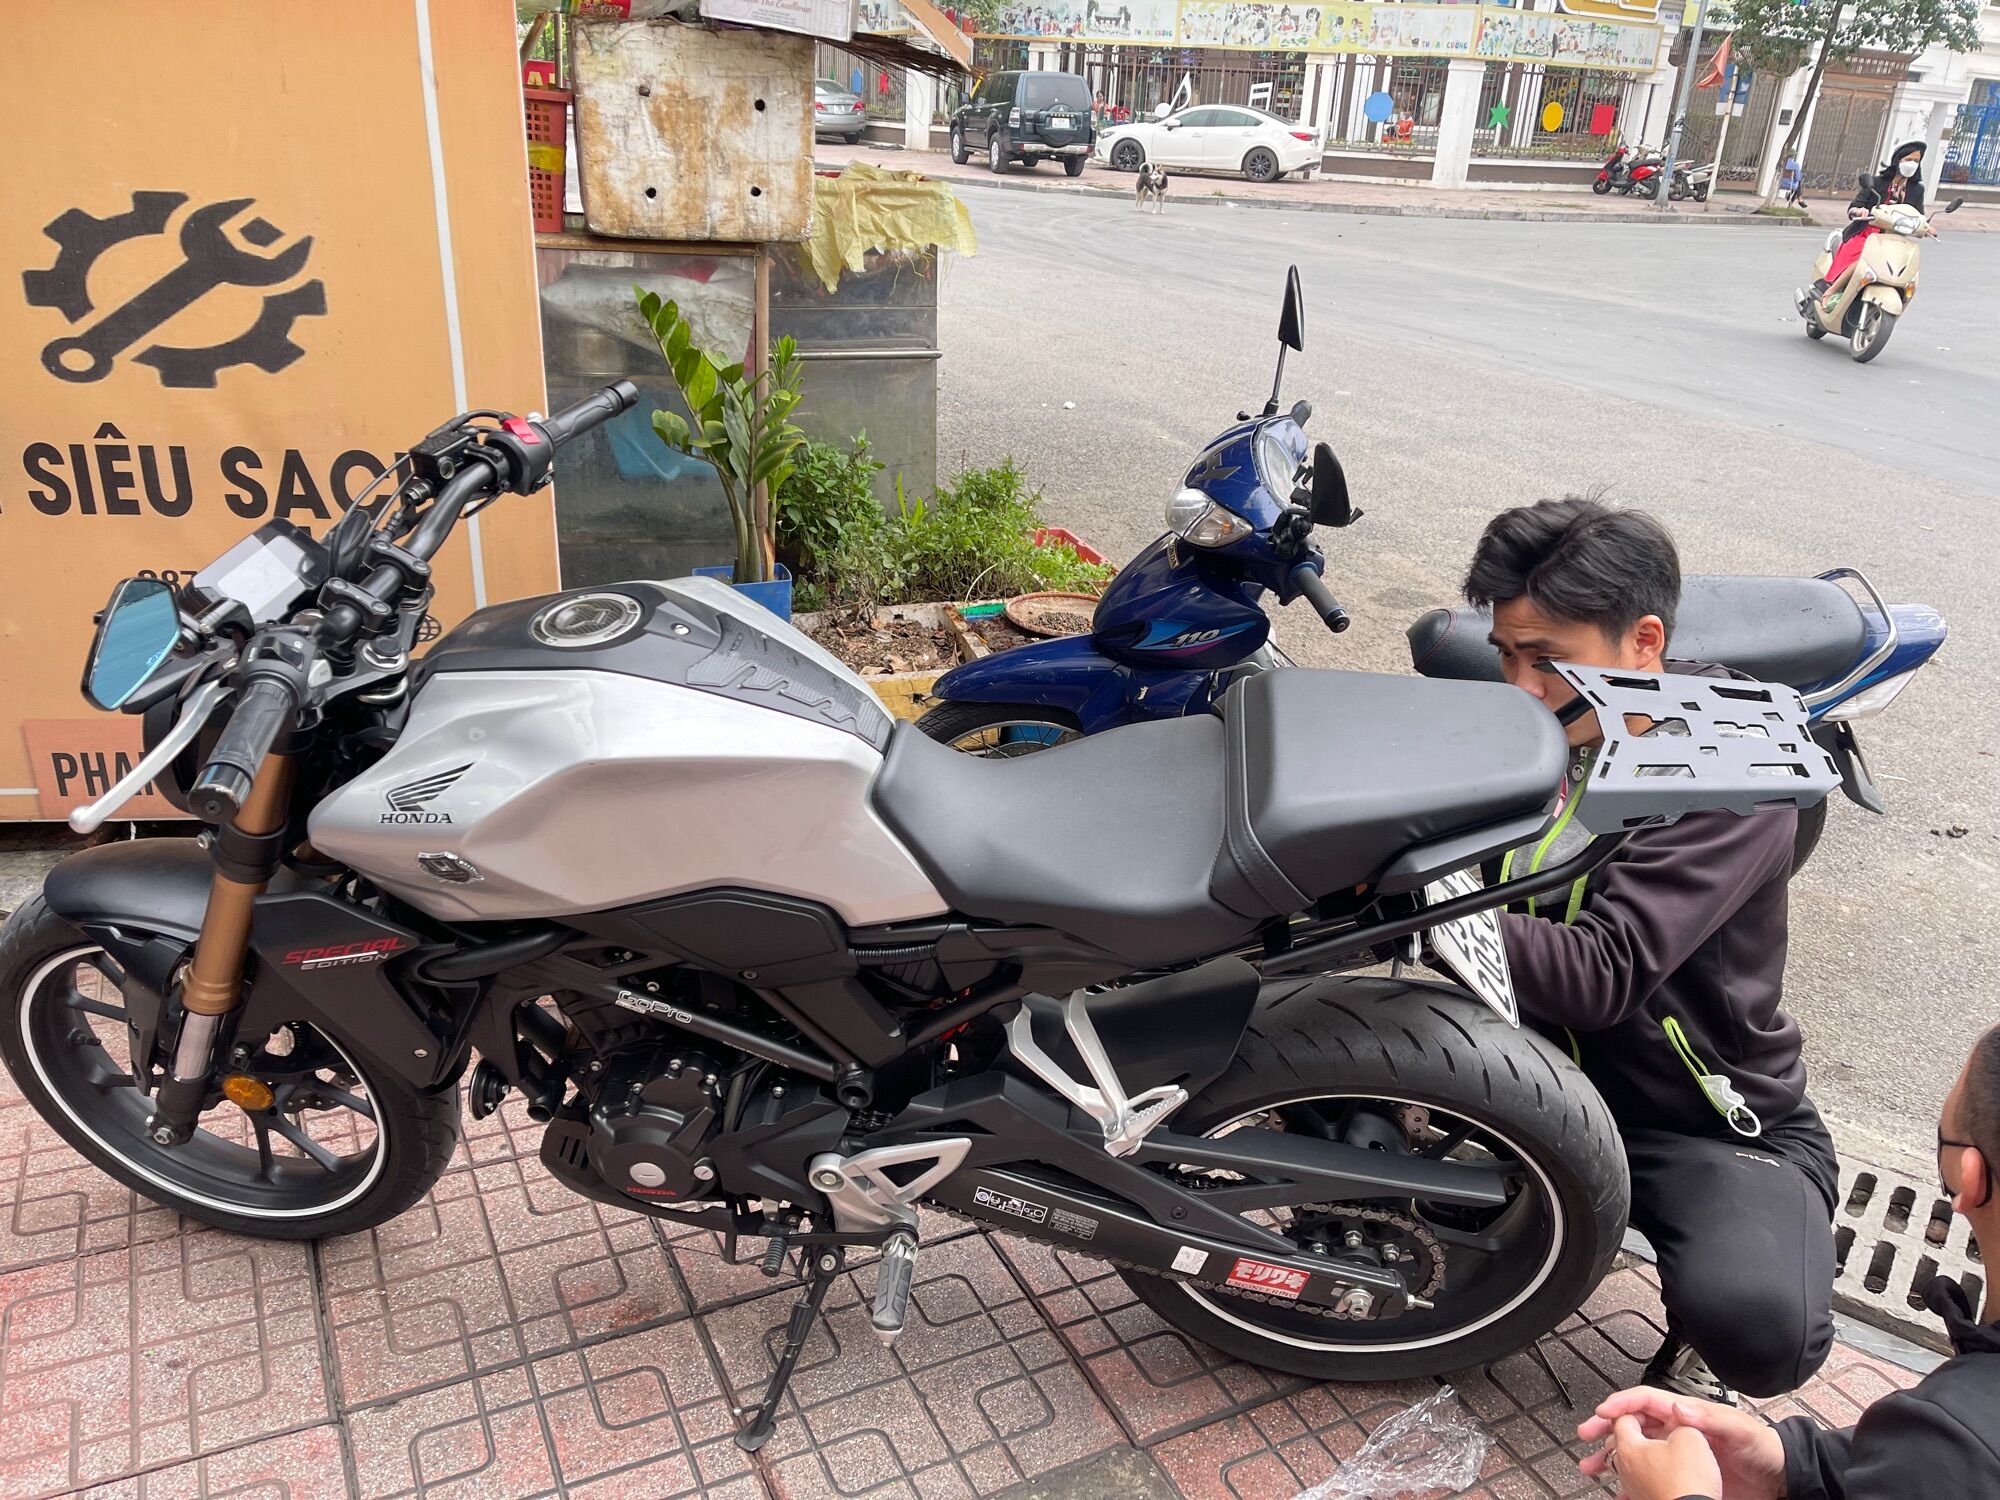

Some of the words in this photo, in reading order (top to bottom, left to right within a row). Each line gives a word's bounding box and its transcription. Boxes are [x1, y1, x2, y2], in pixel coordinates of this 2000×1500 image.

[22, 422, 194, 518] SIÊU
[1168, 542, 1179, 568] ONDA
[1174, 629, 1220, 648] 110
[378, 812, 454, 825] HONDA
[282, 936, 408, 965] SPECIAL
[300, 953, 390, 971] EDITION
[618, 990, 693, 1024] GoPro
[1235, 1261, 1306, 1289] モリワキ
[1227, 1280, 1298, 1299] ENGINEERING
